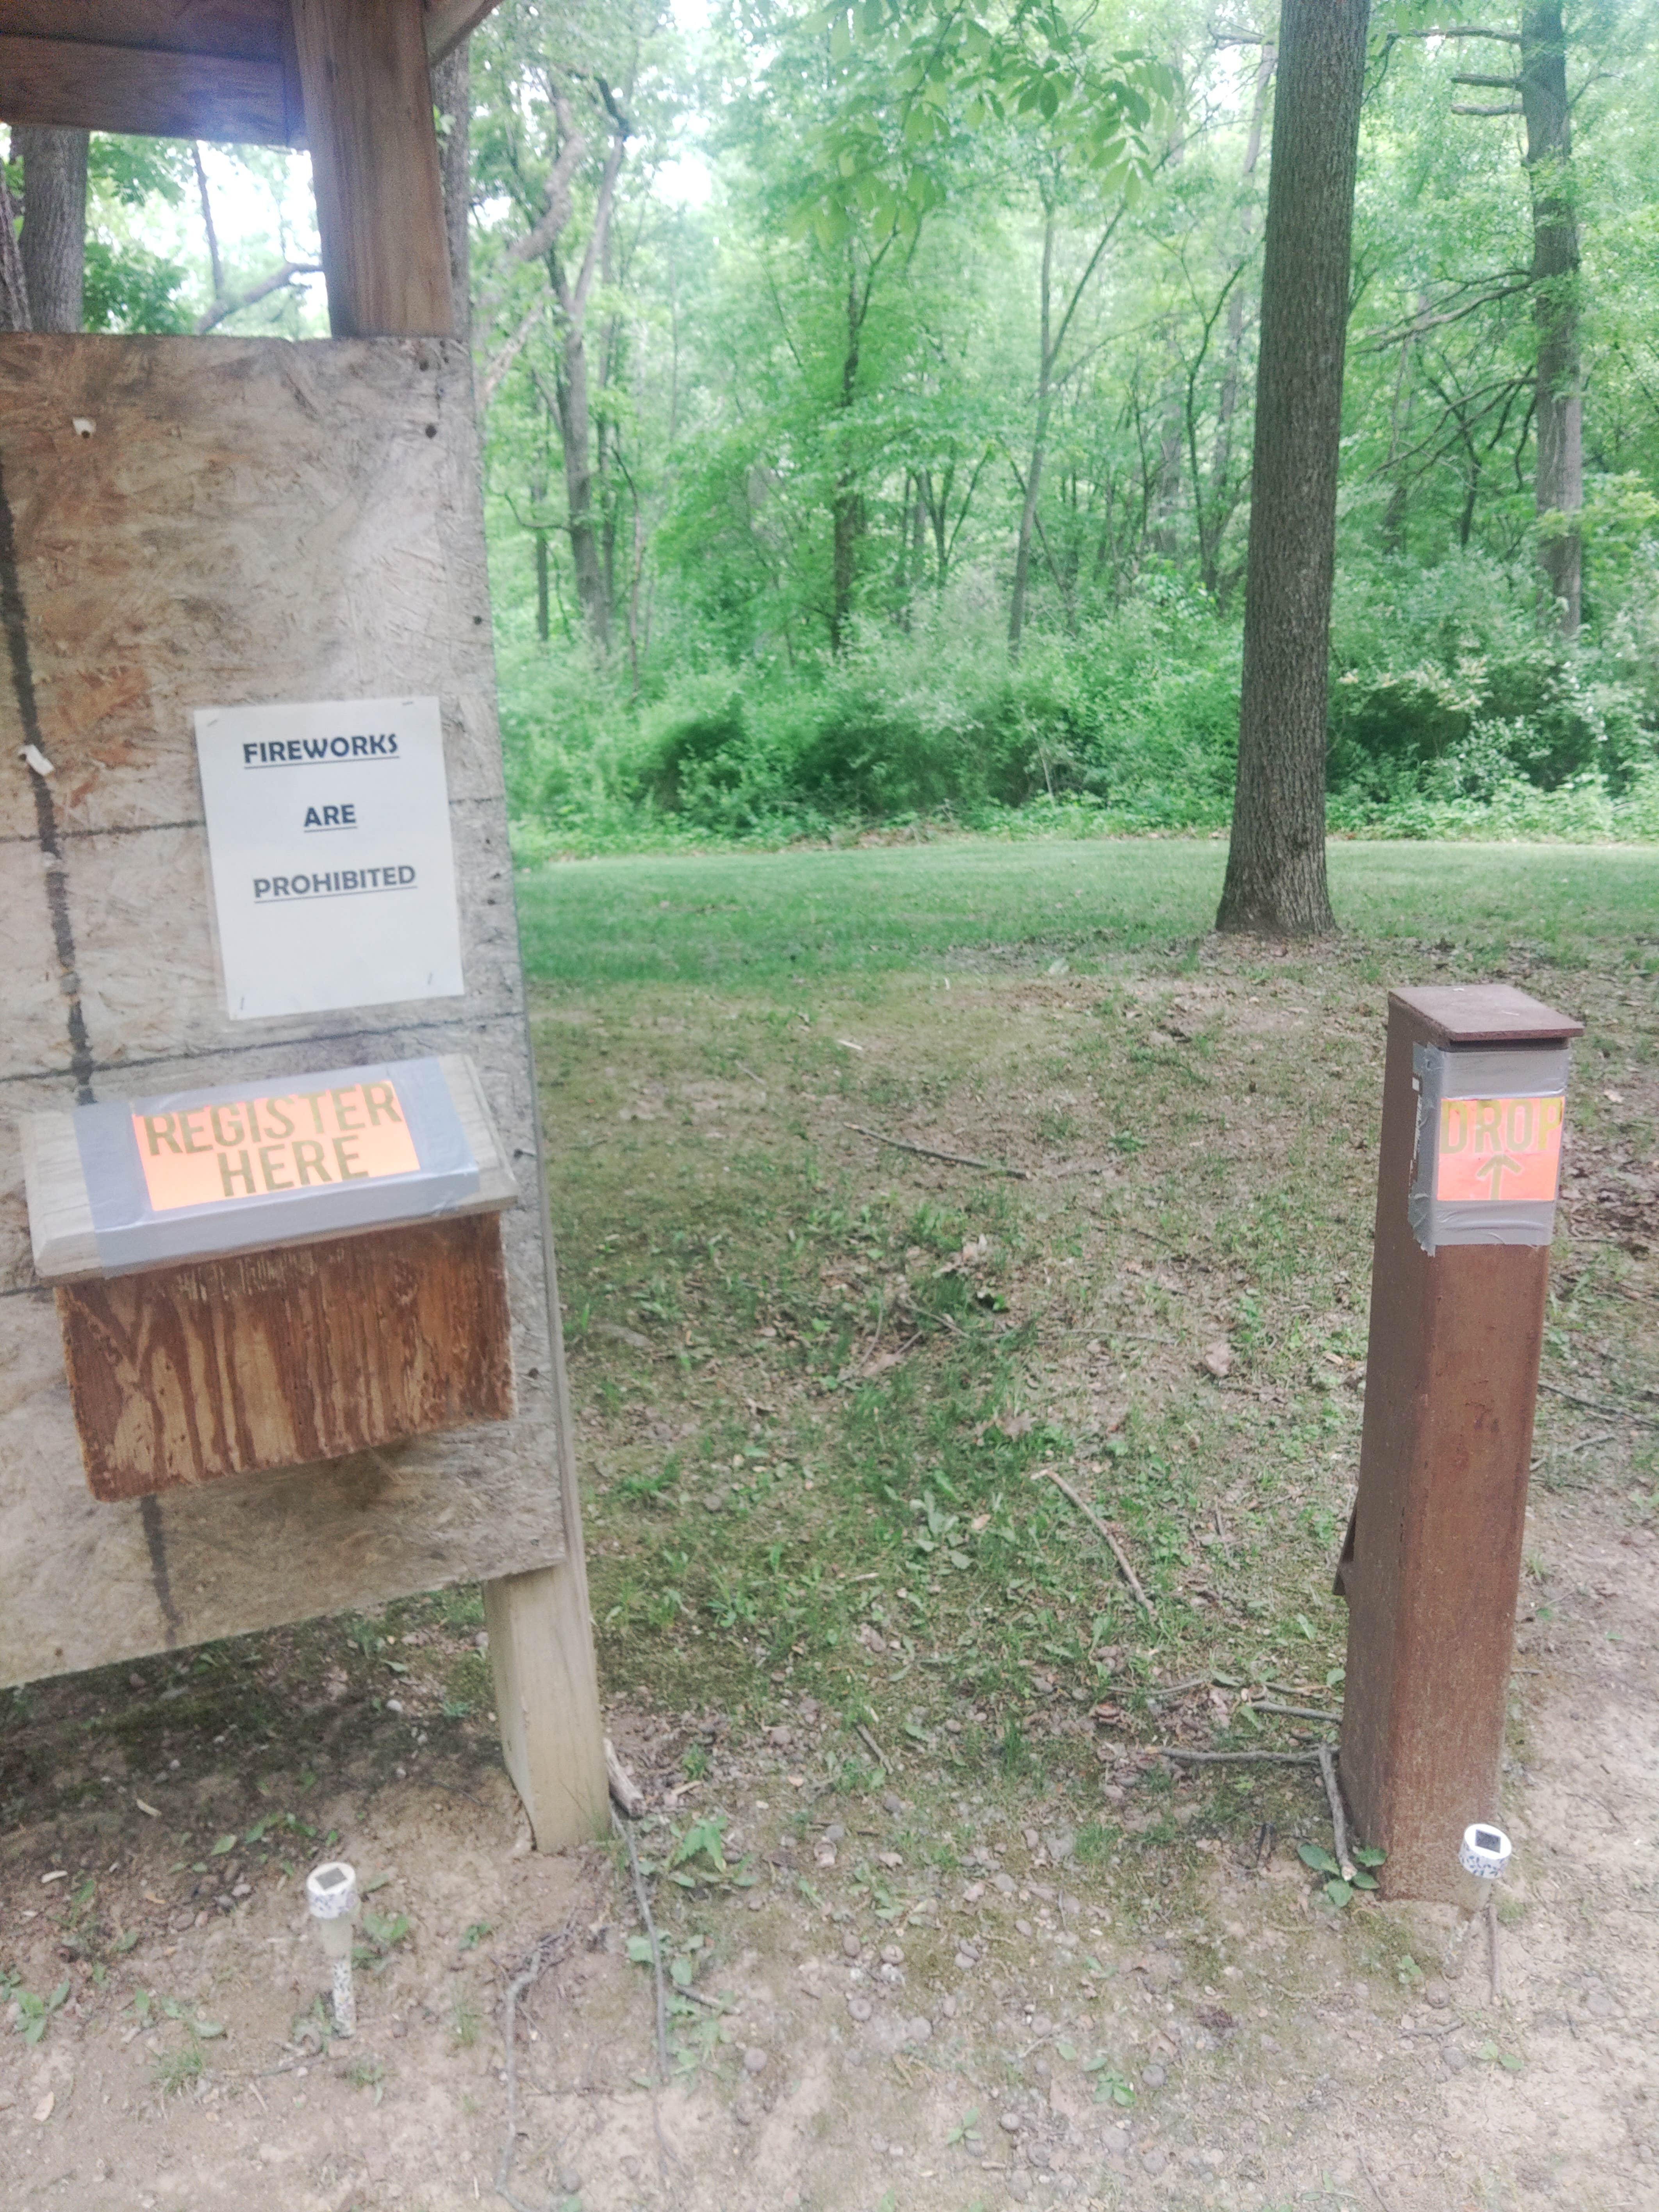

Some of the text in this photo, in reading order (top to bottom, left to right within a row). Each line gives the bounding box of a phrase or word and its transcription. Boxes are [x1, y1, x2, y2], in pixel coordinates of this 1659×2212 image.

[243, 733, 398, 763] FIREWORKS
[304, 804, 356, 827] ARE
[253, 865, 416, 898] PROHIBITED
[143, 1081, 402, 1156] REGISTER
[1440, 1098, 1563, 1154] DROP
[217, 1135, 369, 1197] HERE
